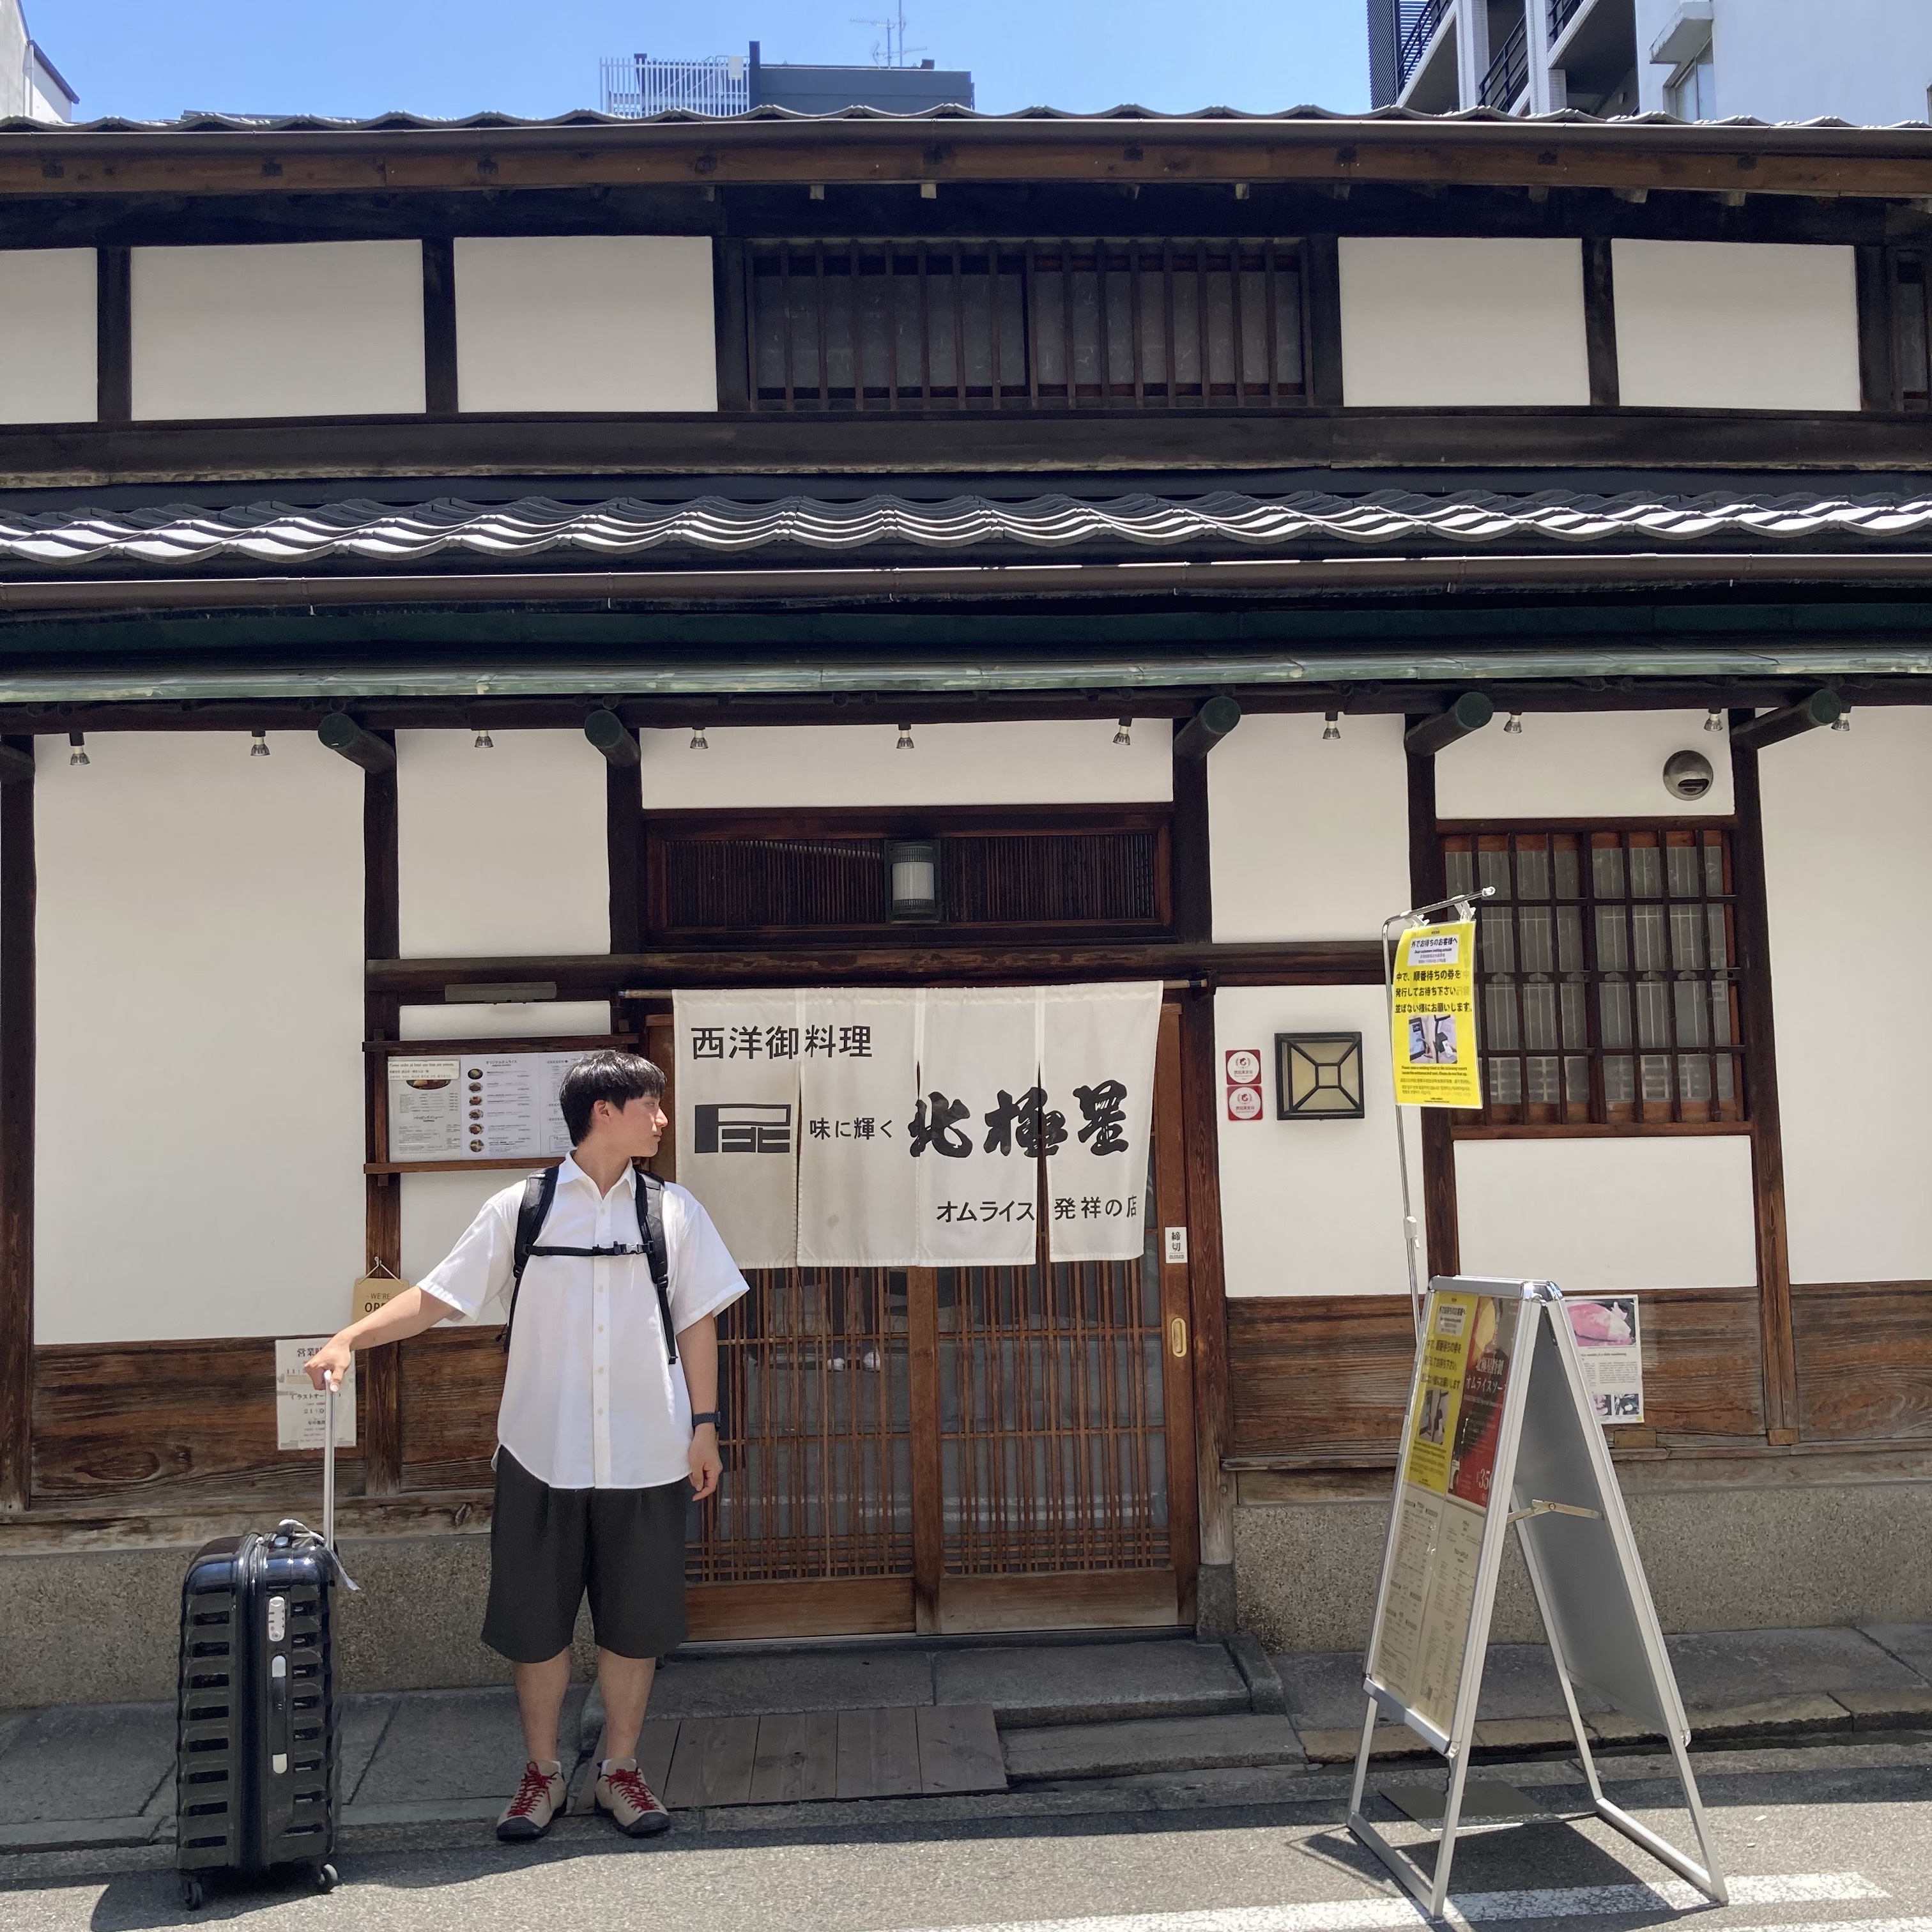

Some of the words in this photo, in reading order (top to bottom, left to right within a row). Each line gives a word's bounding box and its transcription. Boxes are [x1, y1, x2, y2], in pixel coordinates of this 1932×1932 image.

[691, 1025, 873, 1059] 西洋御料理
[809, 1117, 893, 1140] 味に輝く
[907, 1080, 1130, 1158] 北極星
[1171, 1231, 1181, 1252] 締切
[365, 1302, 387, 1313] OP
[1466, 1375, 1506, 1393] オムライスソー
